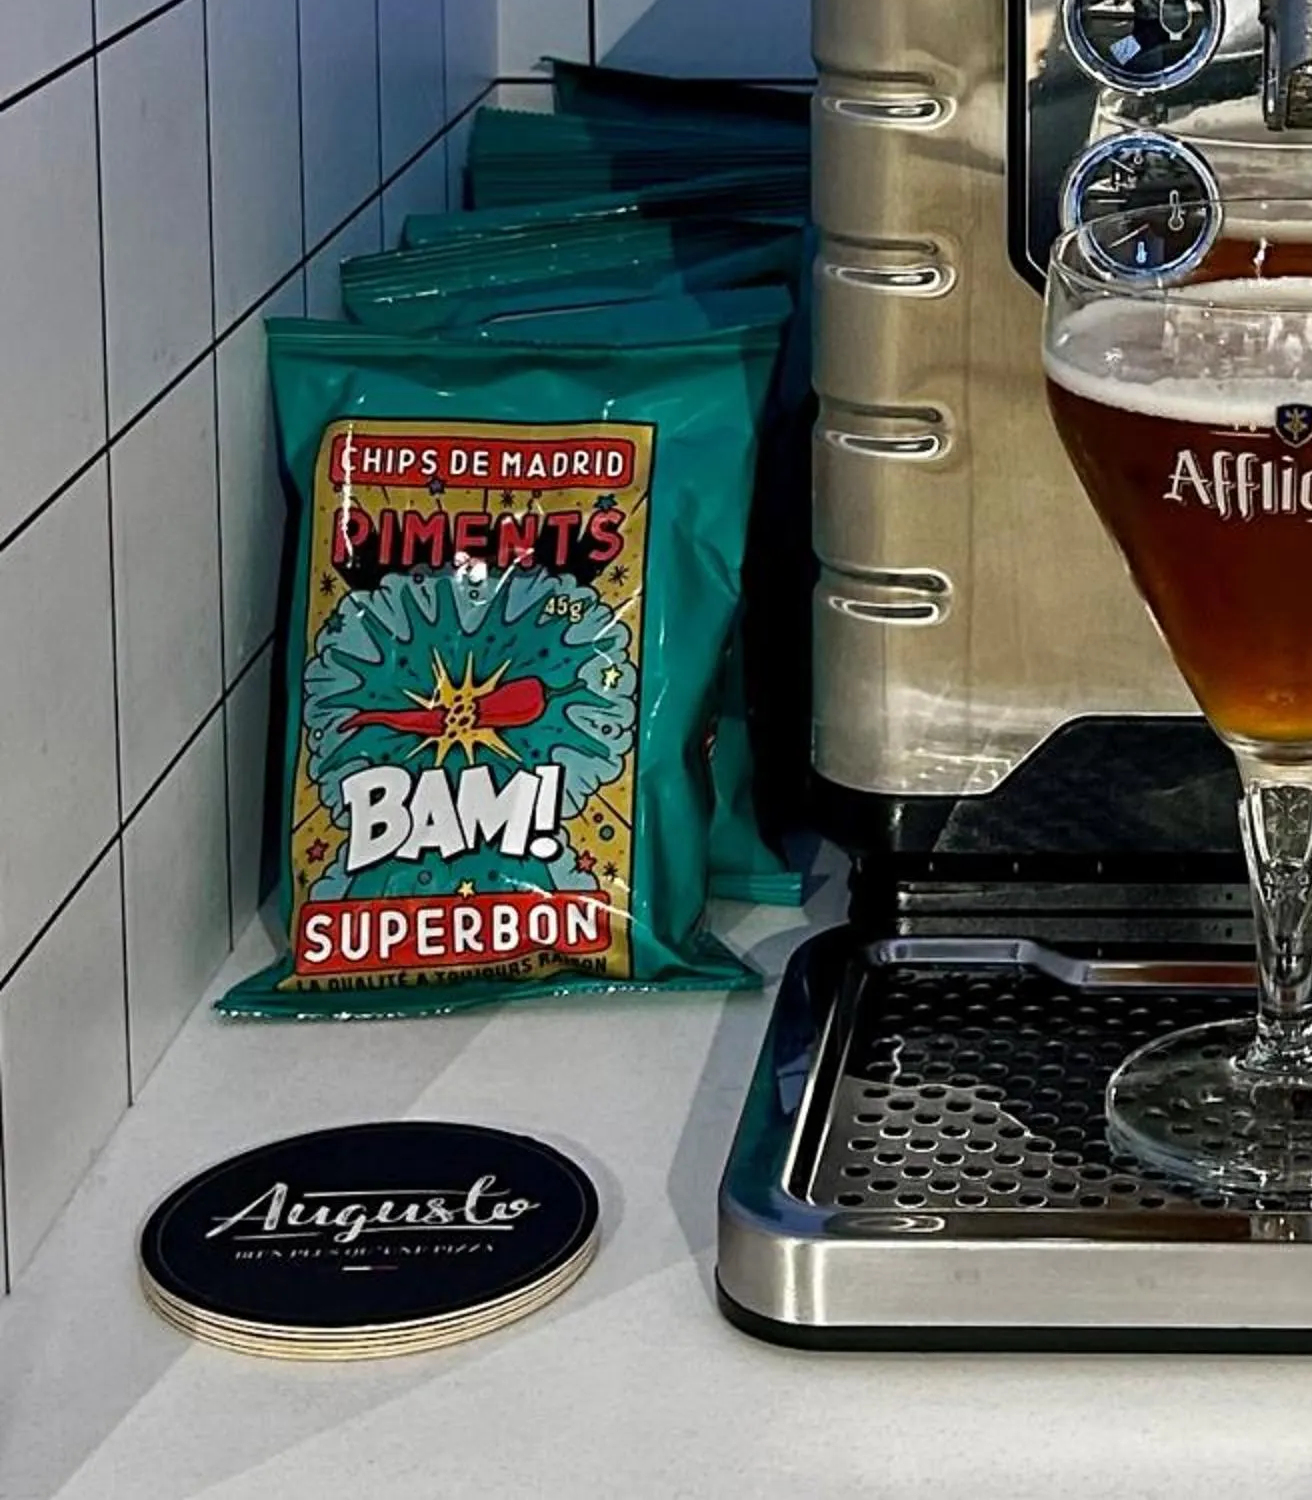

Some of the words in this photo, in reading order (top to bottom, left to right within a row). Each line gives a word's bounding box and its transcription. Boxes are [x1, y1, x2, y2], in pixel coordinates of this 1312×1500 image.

[341, 446, 439, 475] CHIPS
[450, 450, 490, 476] DE
[501, 450, 624, 478] MADRID
[331, 507, 627, 569] PIMENTS
[544, 595, 582, 622] 45g
[342, 763, 565, 871] BAM!
[303, 901, 599, 963] SUPERBON
[205, 1174, 541, 1243] Augusto
